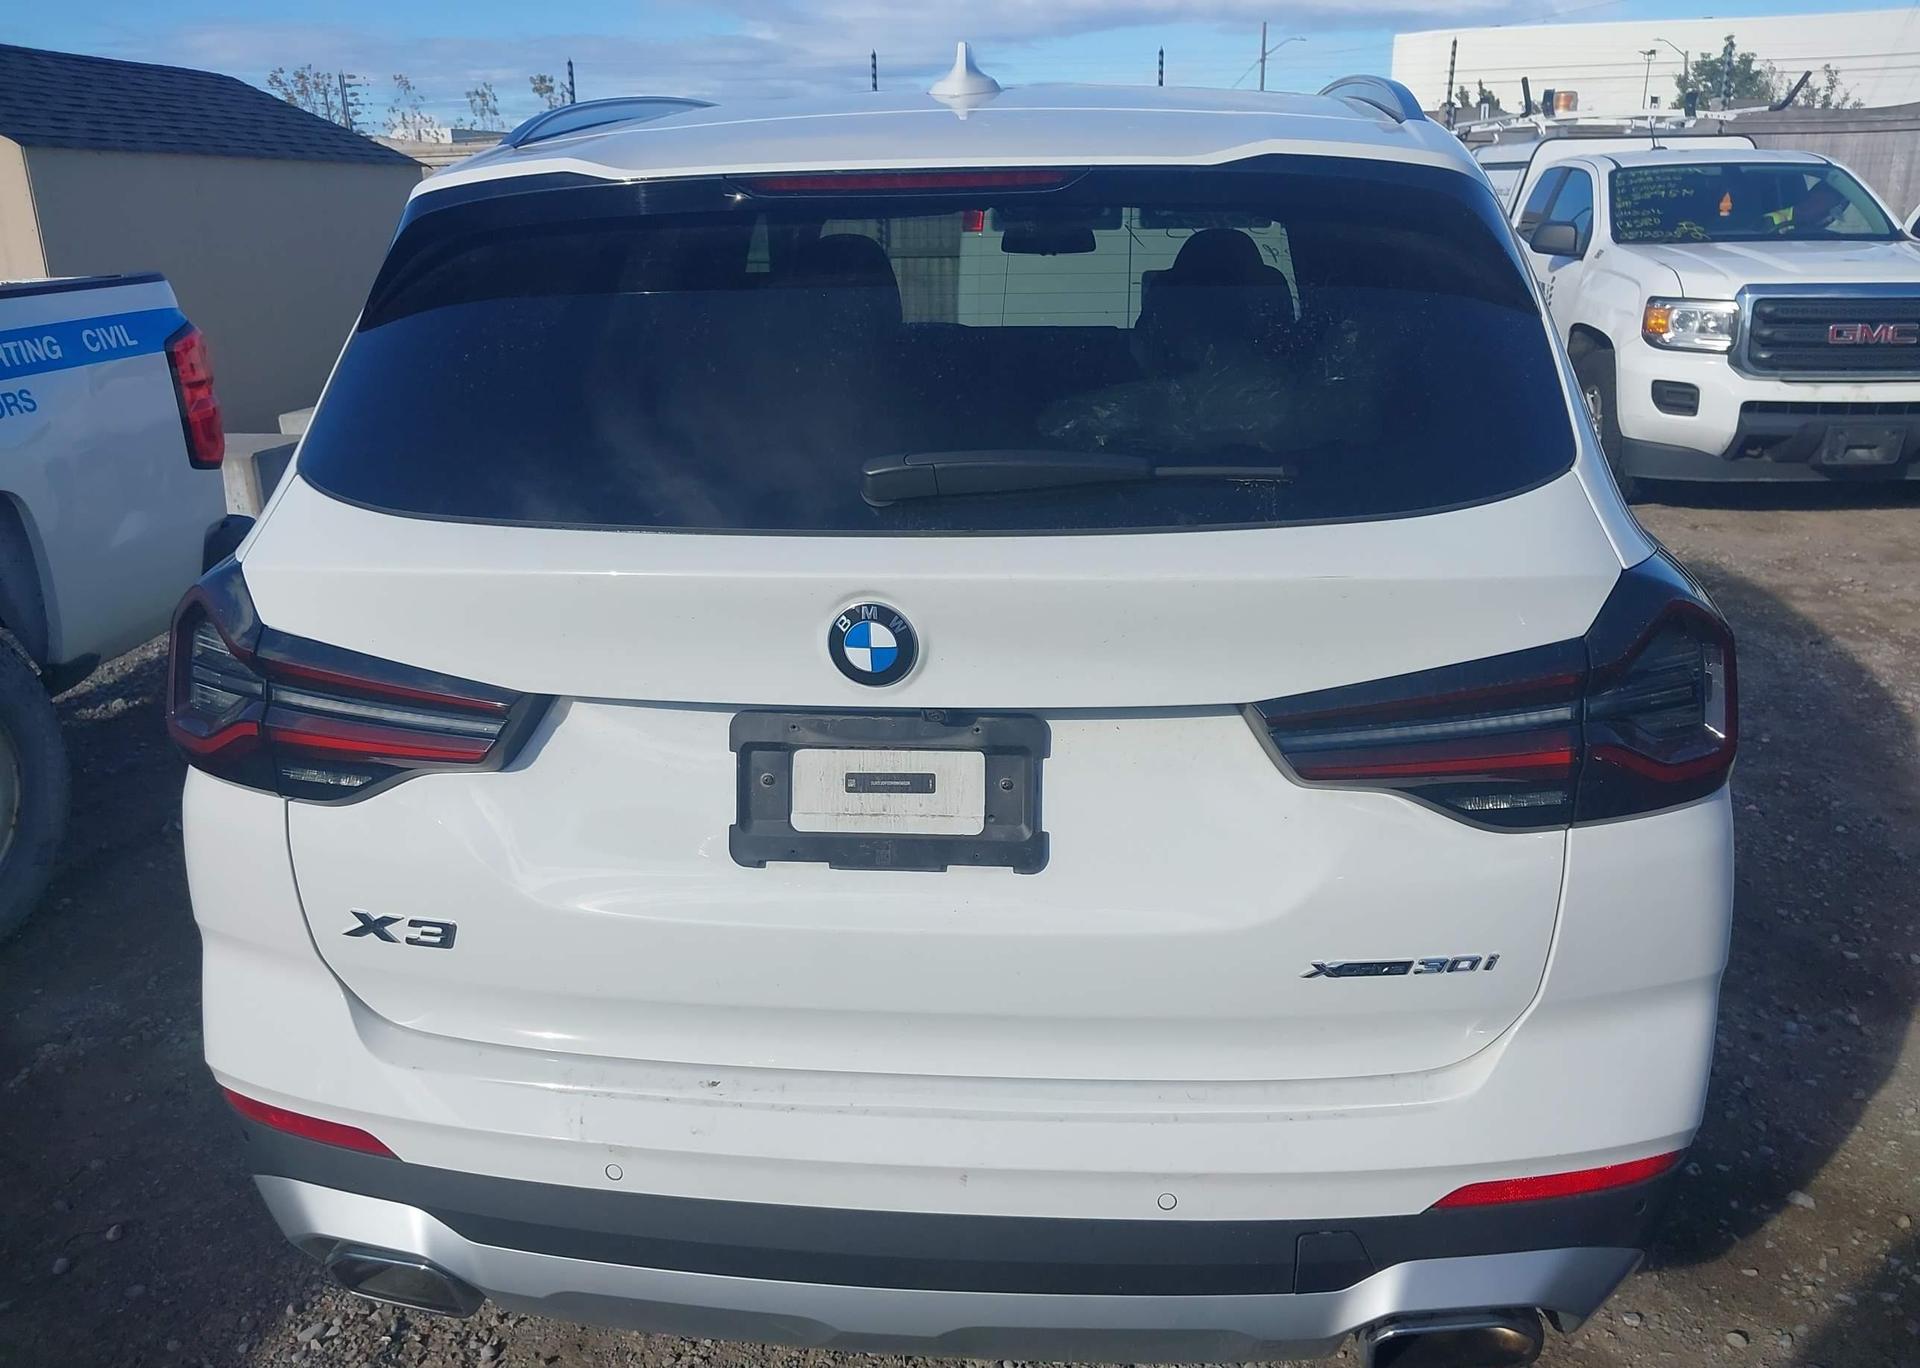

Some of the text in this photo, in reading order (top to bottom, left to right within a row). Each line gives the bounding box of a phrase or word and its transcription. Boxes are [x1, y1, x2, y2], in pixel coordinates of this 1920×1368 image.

[81, 324, 138, 352] CIVIL
[1829, 323, 1919, 344] GMC
[0, 388, 37, 420] RS
[836, 605, 907, 633] BMW
[342, 908, 457, 949] X3
